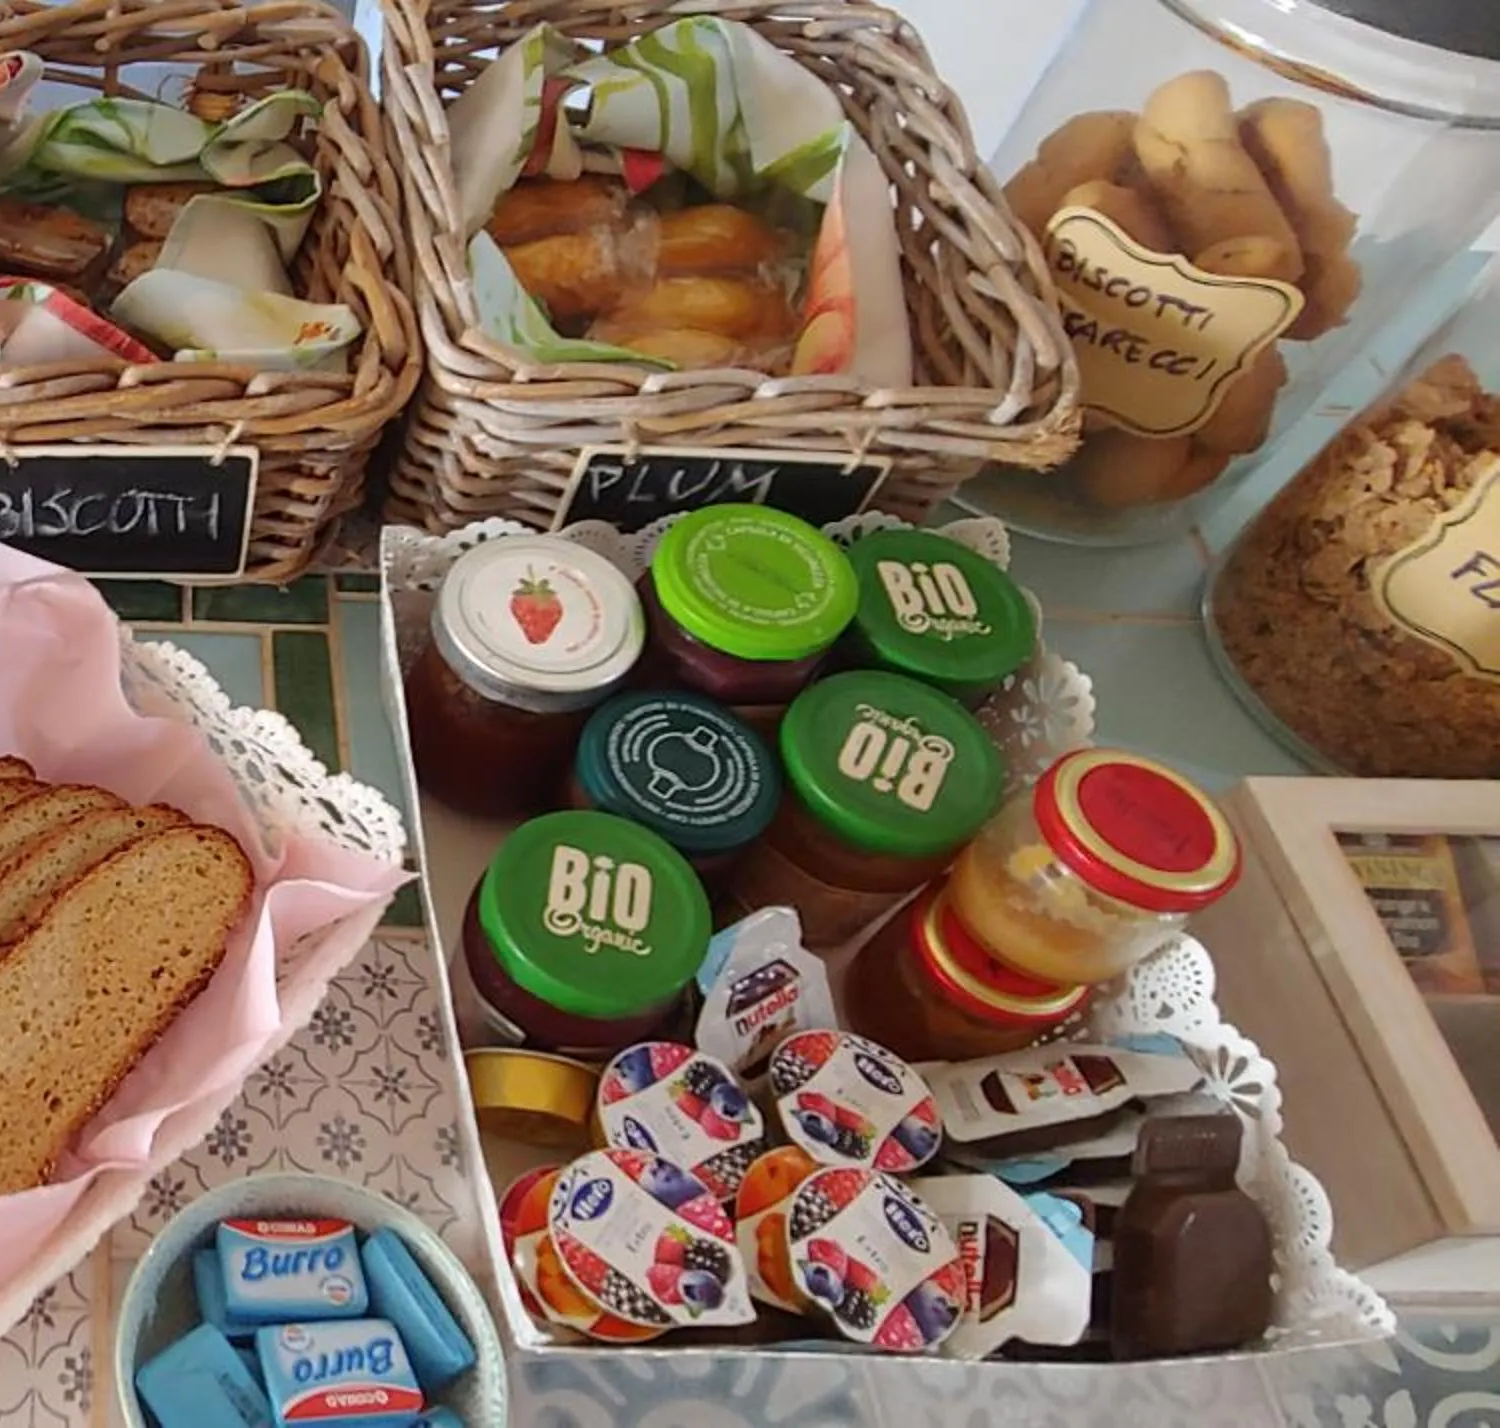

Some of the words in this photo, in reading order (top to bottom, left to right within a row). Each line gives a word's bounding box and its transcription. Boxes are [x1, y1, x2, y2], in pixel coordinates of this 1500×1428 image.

[1056, 237, 1215, 331] BISCOTTI
[588, 460, 781, 505] PLUM
[736, 984, 800, 1036] nutella
[241, 1246, 344, 1281] Burro
[294, 1338, 394, 1382] Burro
